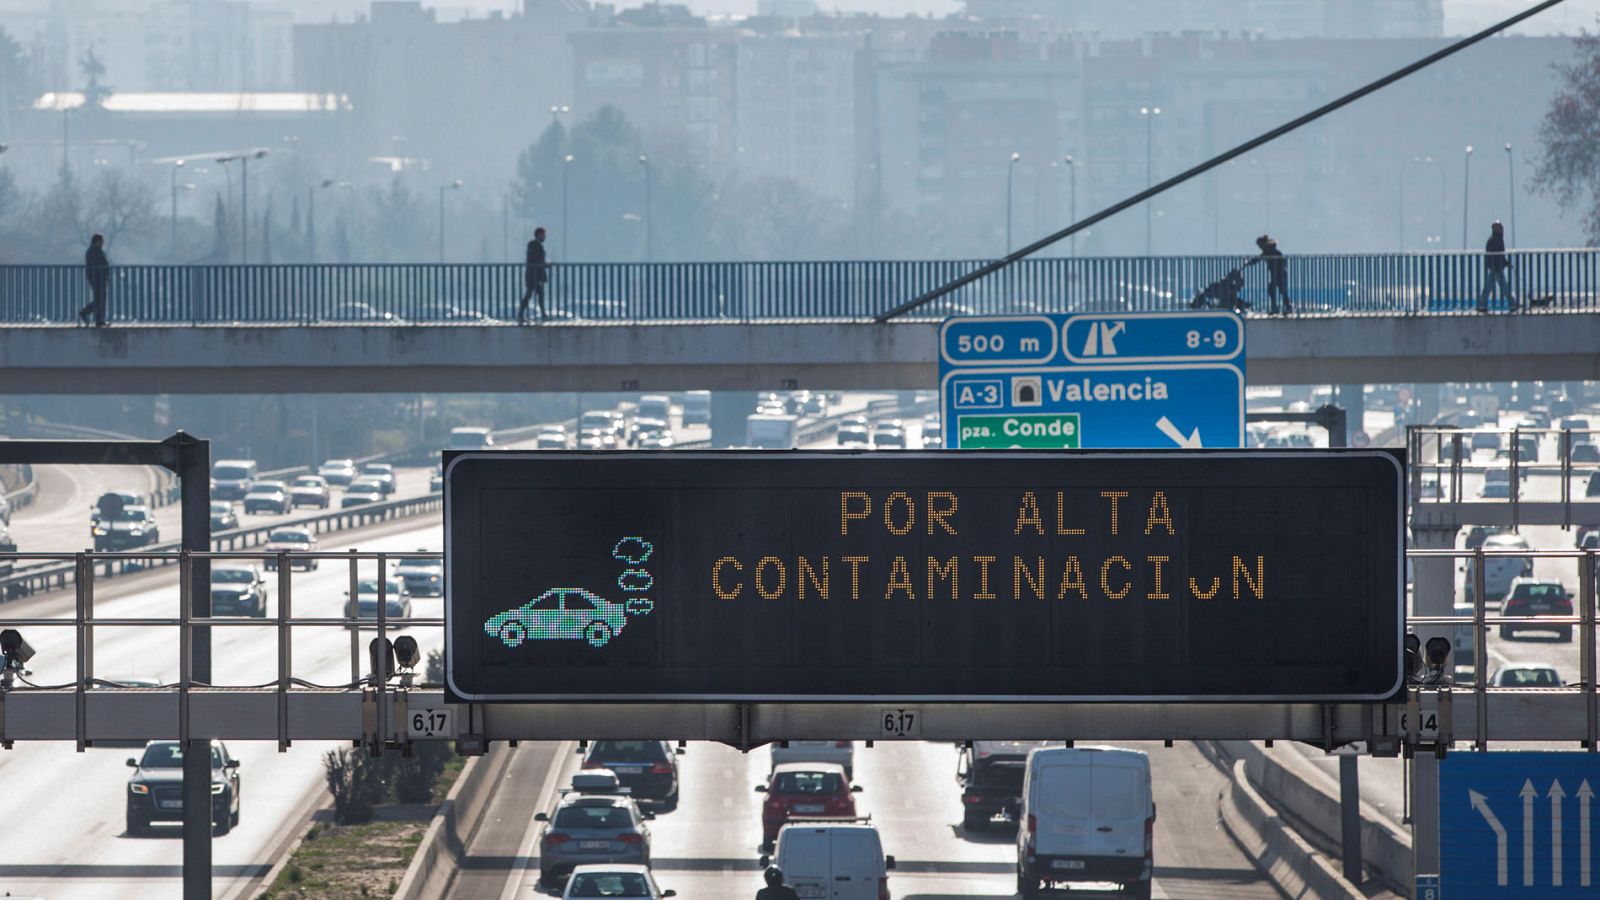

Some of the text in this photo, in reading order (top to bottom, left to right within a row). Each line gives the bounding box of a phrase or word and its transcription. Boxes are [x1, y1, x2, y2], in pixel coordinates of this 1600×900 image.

[958, 335, 1040, 353] 500 m
[1185, 330, 1227, 349] 8-9
[958, 385, 999, 404] A-3
[1047, 376, 1169, 402] Valencia
[961, 418, 1076, 441] pza. Conde
[840, 491, 1176, 535] POR ALTA
[412, 713, 447, 733] 6,17
[884, 713, 915, 733] 6,17
